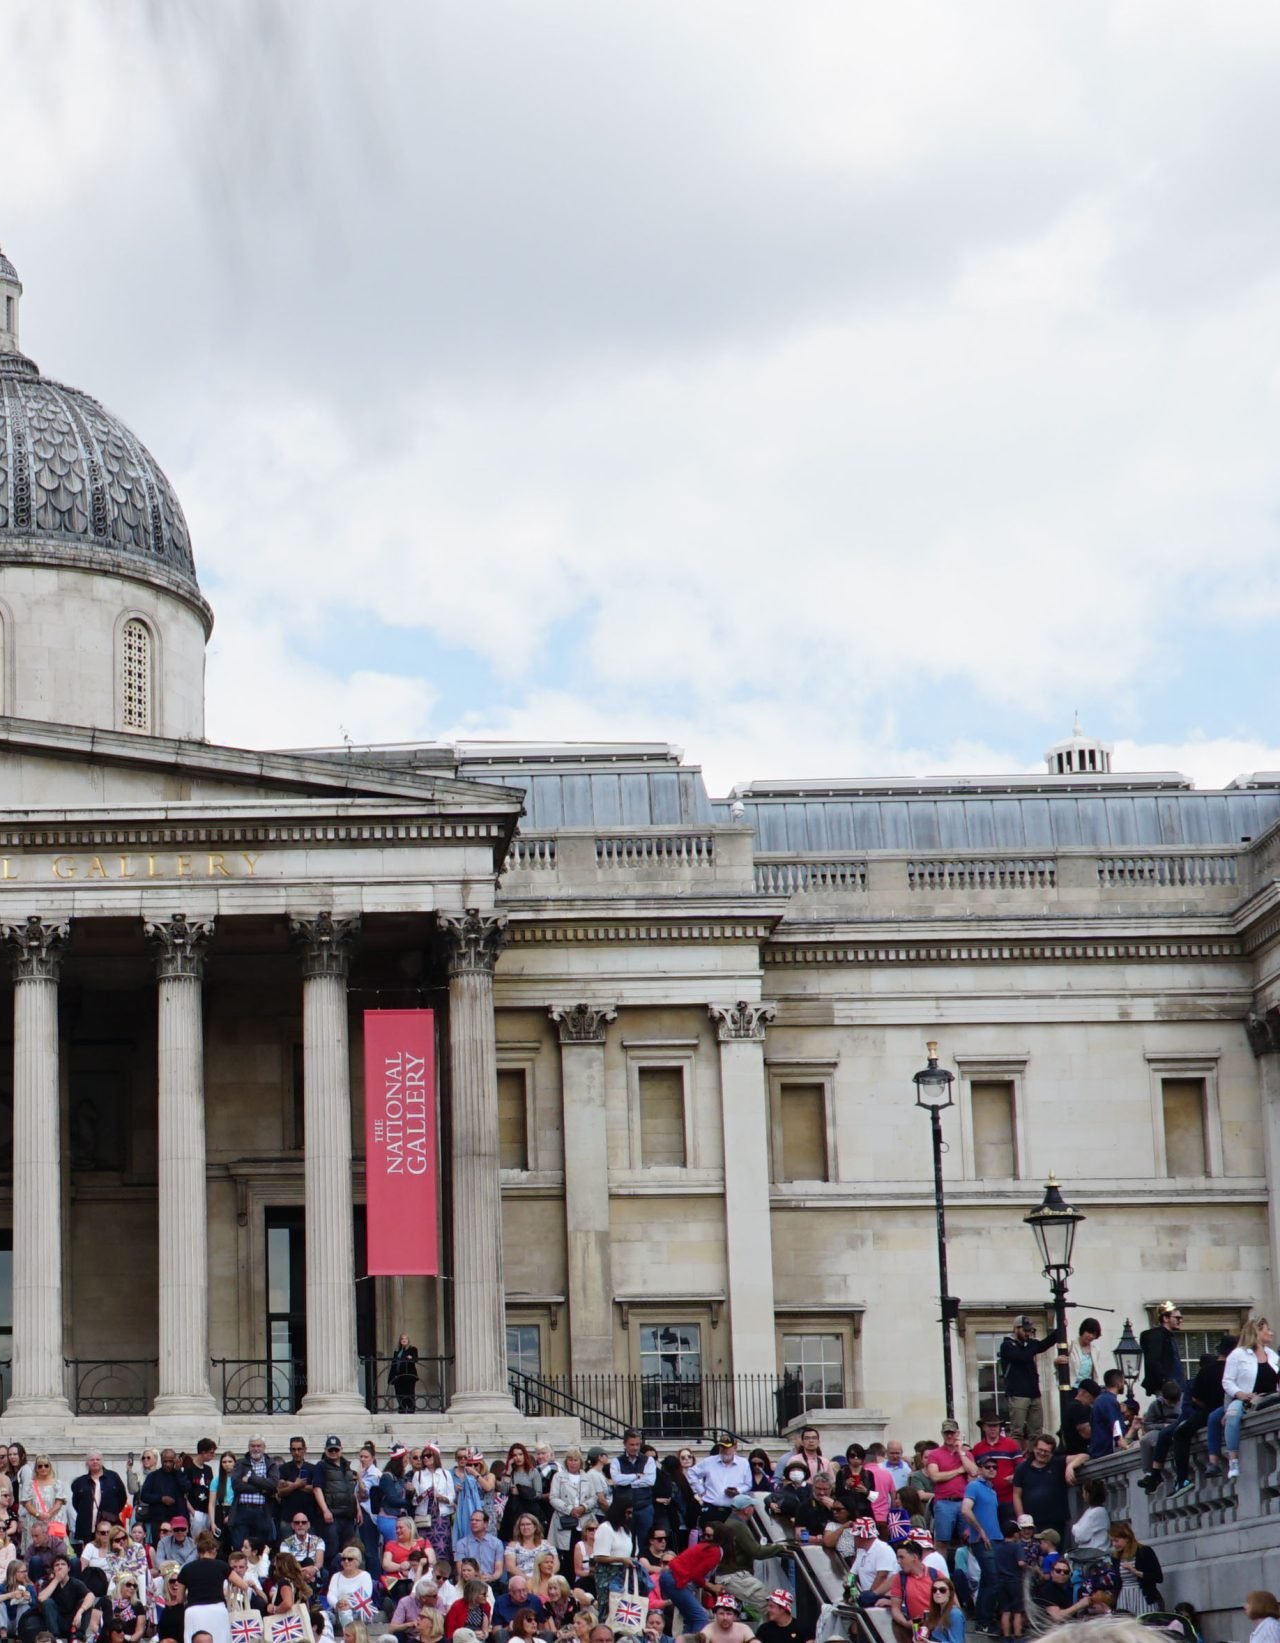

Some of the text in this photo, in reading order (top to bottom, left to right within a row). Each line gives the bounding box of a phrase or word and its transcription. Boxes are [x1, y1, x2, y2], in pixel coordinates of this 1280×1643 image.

[51, 853, 265, 879] GALLERY
[375, 1119, 384, 1143] THE
[385, 1051, 404, 1174] NATIONAL
[405, 1051, 427, 1175] GALLERY
